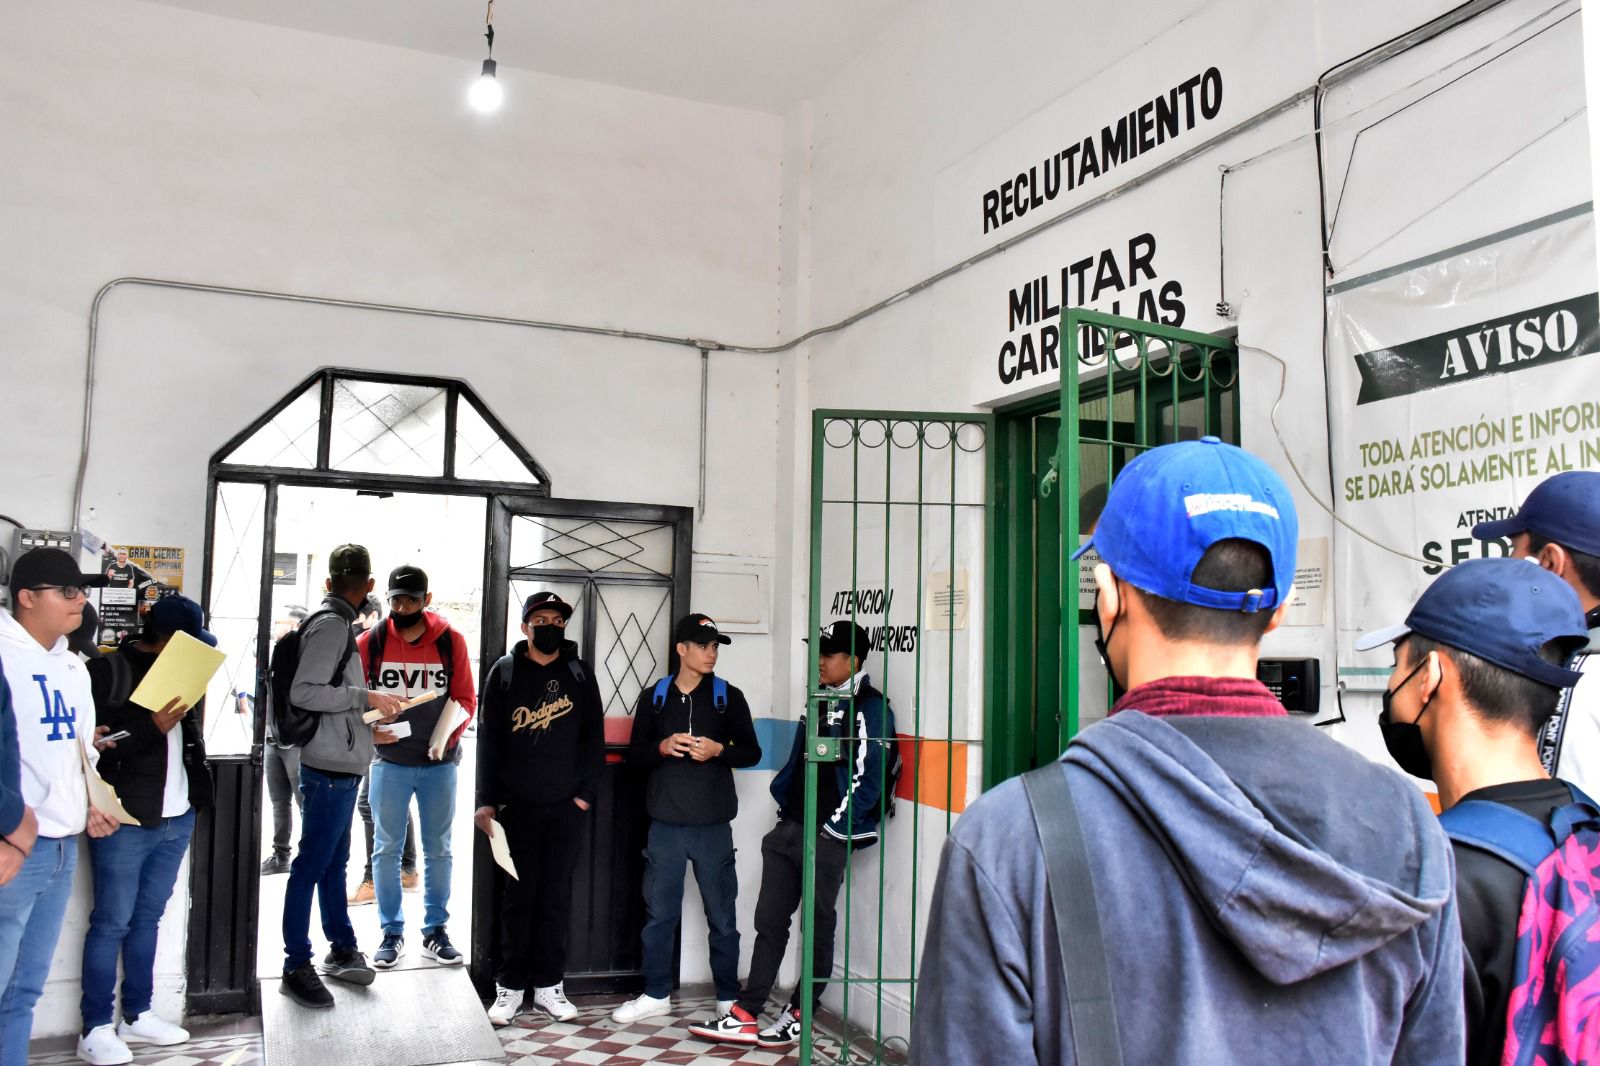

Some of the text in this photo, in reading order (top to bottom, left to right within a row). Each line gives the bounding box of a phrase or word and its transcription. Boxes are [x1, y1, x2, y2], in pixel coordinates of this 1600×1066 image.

[983, 67, 1223, 235] RECLUTAMIENTO
[1009, 232, 1157, 332] MILITAR
[998, 280, 1186, 384] CARILLAS
[1440, 309, 1578, 379] AVISO
[1360, 438, 1405, 468] TODA
[1410, 413, 1505, 460] ATENCIÓN
[1512, 415, 1524, 443] E
[1345, 475, 1364, 501] SE
[1369, 464, 1415, 499] DARÁ
[1421, 447, 1538, 491] SOLAMENTE
[1545, 443, 1573, 474] AL
[1457, 506, 1522, 528] ATENTA
[129, 547, 182, 560] GRAN CIERRE
[144, 561, 152, 569] DE
[830, 588, 894, 615] ATENCION
[32, 674, 76, 741] LA
[512, 694, 574, 732] Dodgers
[1546, 715, 1561, 742] PONY
